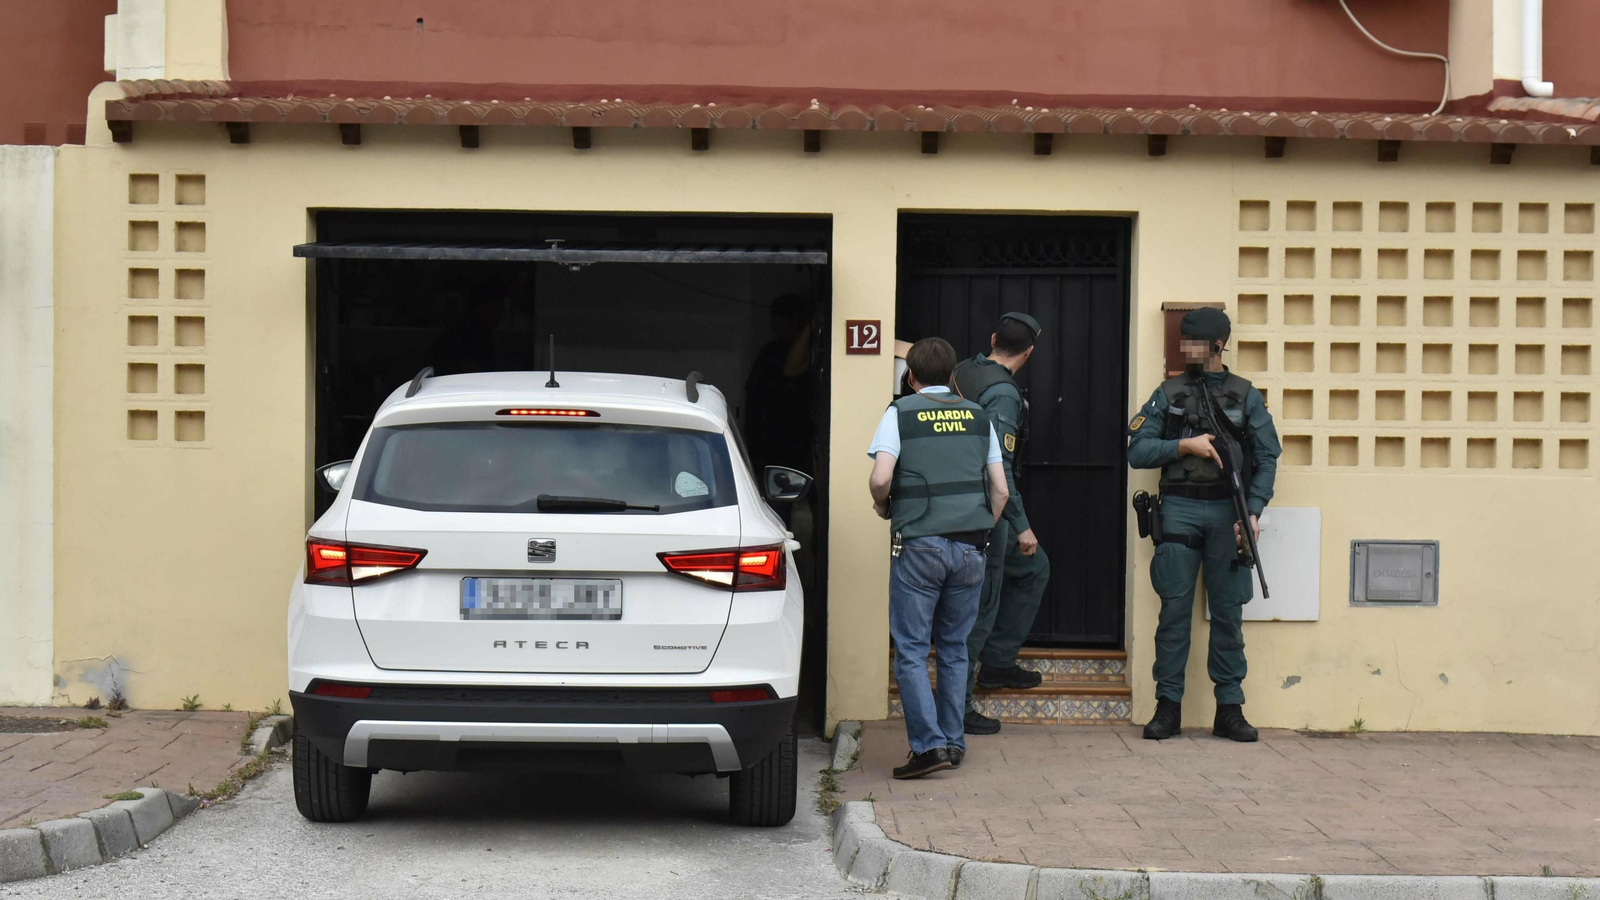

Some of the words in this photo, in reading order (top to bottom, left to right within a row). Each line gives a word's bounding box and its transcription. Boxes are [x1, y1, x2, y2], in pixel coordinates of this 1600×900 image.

[849, 324, 878, 349] 12
[917, 410, 974, 422] GUARDIA
[933, 421, 966, 433] CIVIL
[493, 640, 590, 650] ATECA
